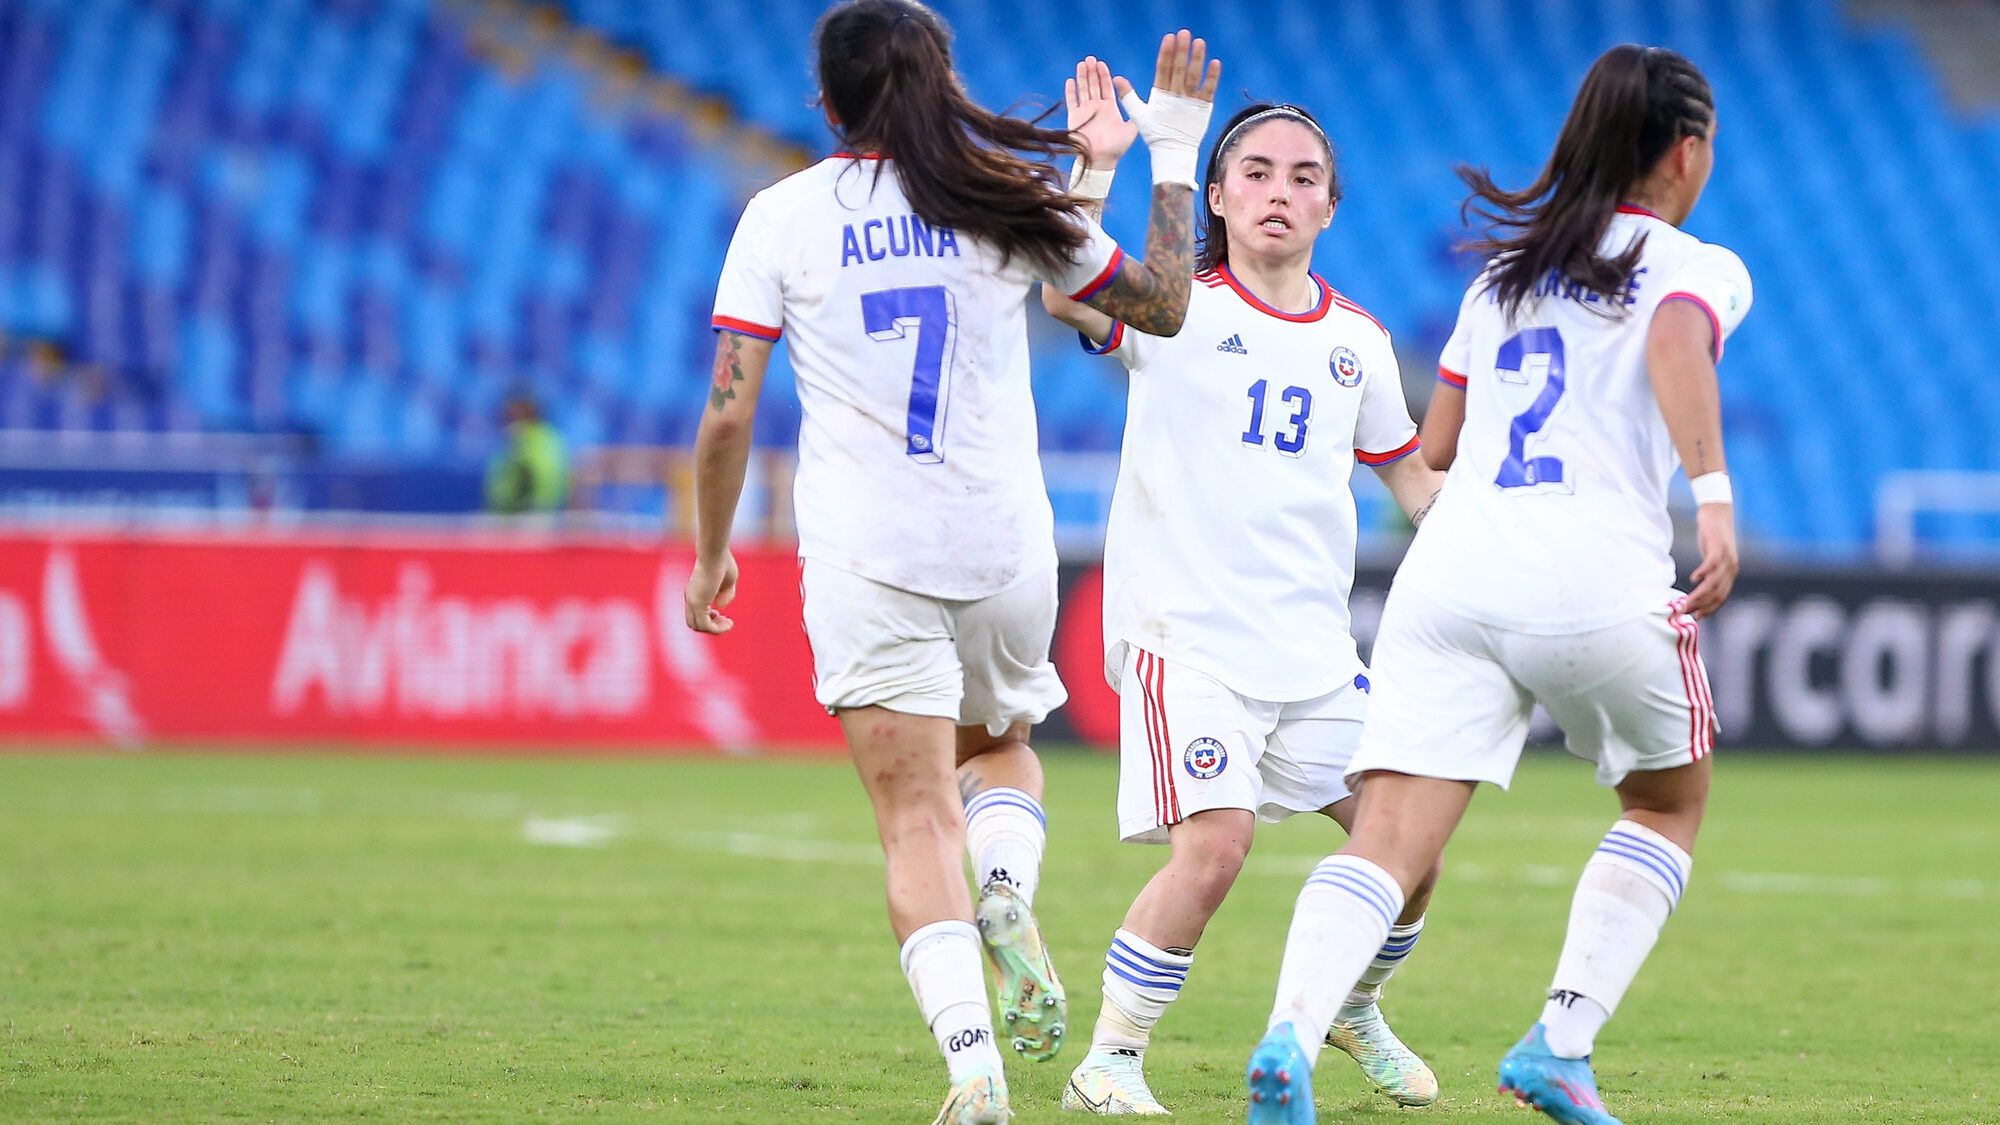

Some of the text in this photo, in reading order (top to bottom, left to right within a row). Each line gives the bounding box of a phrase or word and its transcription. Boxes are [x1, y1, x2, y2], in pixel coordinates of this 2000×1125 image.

[860, 285, 957, 464] 7
[1242, 379, 1317, 458] 13
[1495, 327, 1575, 495] 2
[272, 560, 652, 714] Avianca
[1712, 593, 2000, 743] rcar
[950, 1029, 989, 1053] GOAT
